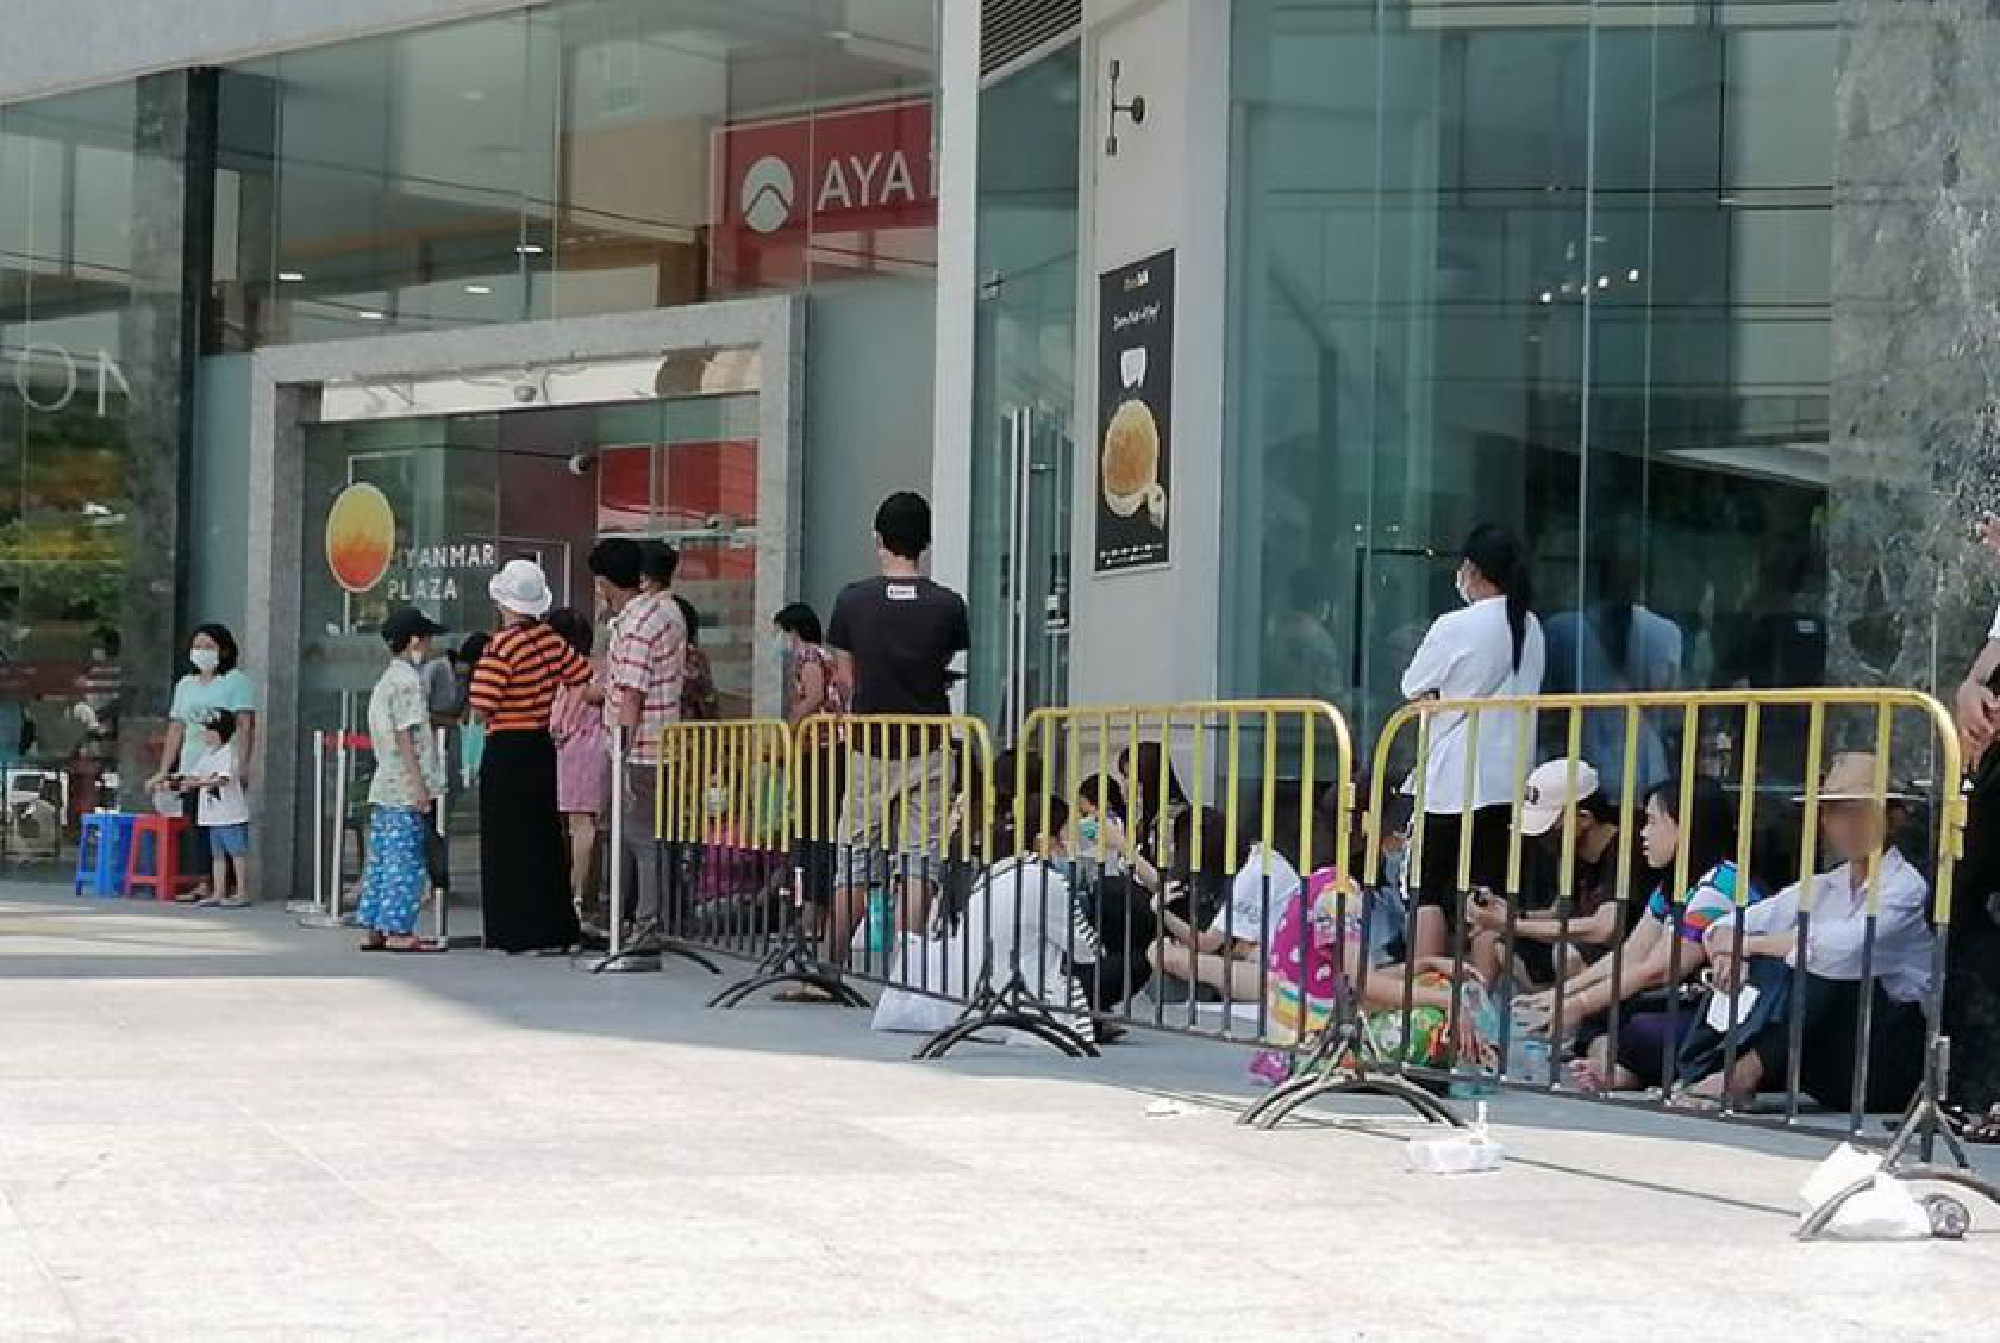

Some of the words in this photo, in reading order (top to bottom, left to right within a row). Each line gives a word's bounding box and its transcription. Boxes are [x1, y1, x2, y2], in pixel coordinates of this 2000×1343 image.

[816, 149, 915, 212] AYA
[396, 543, 496, 569] YANMAR
[387, 576, 458, 600] PLAZA
